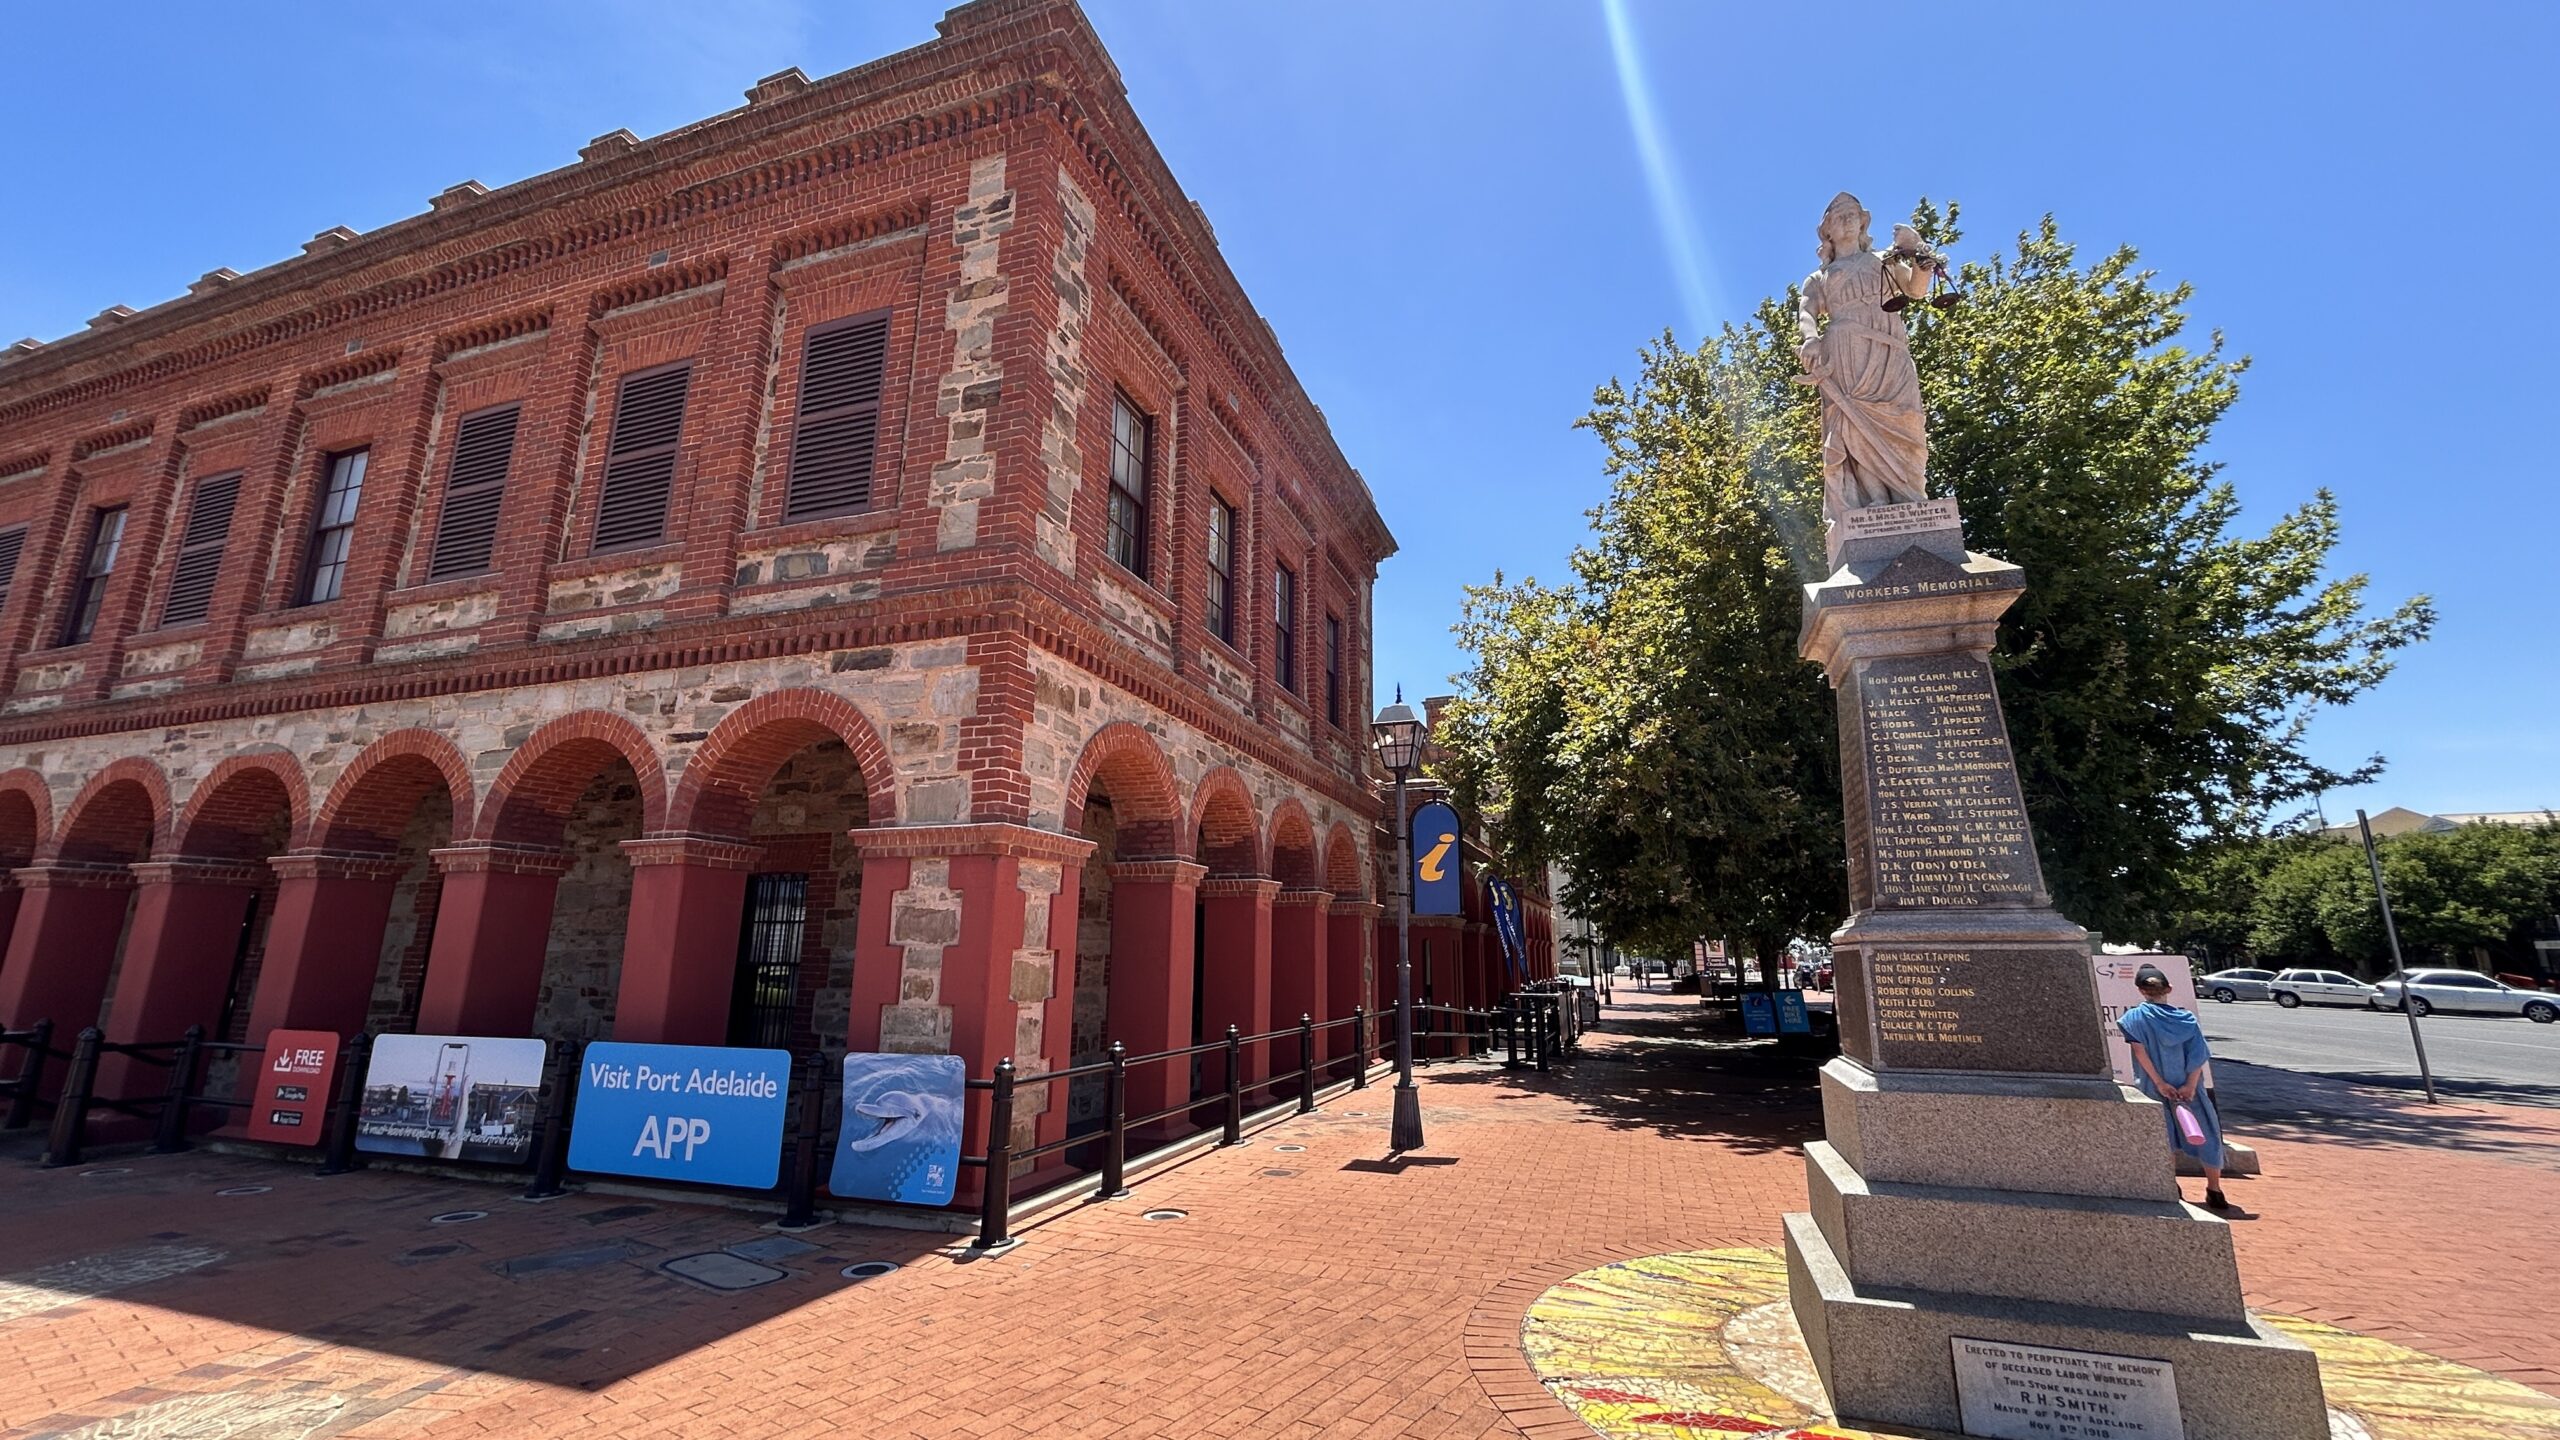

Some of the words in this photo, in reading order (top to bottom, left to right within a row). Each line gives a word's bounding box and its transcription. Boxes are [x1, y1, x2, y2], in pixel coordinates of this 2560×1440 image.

[1844, 585, 1910, 599] WORKERS
[1891, 675, 1917, 683] JOHN
[1916, 824, 1960, 833] CONDON
[1896, 849, 1921, 858] RUBY
[1925, 848, 1973, 858] HAMMOND
[1949, 860, 1986, 870] O'DEA
[1909, 873, 1954, 883] (JIMMY)
[1958, 872, 2003, 881] TUNCKS
[1911, 884, 1939, 893] JAMES
[1942, 883, 1966, 894] (JIM)
[1982, 882, 2032, 893] CAVANAGH
[1898, 896, 1915, 906] JIM
[1932, 895, 1978, 905] DOUGLAS
[1875, 952, 1898, 961] JOHN
[1899, 952, 1923, 962] (JACK)
[1932, 952, 1970, 962] TAPPING
[1874, 963, 1893, 973] RON
[1896, 963, 1941, 973] CONNOLLY
[1875, 975, 1893, 984] RON
[1898, 975, 1934, 985] GIFFARD
[1877, 986, 1909, 996] ROBERT
[1911, 987, 1935, 996] (BOB)
[1938, 987, 1975, 997] COLLINS
[1878, 998, 1904, 1007] KEITH
[1880, 1009, 1916, 1019] GEORGE
[1918, 1010, 1959, 1019] WHITTEN
[1880, 1020, 1913, 1030] EULALIE
[1937, 1021, 1958, 1031] TAPP
[1883, 1032, 1914, 1041] ARTHUR
[1939, 1033, 1983, 1043] MORTIMER
[294, 1048, 325, 1066] FREE
[590, 1062, 630, 1090] Visit
[636, 1065, 681, 1093] Port
[684, 1068, 777, 1099] Adelaide
[632, 1115, 711, 1162] APP
[1964, 1344, 2006, 1358] ERECTED
[2009, 1350, 2023, 1360] TO
[2027, 1353, 2089, 1368] PERPETUATE
[2092, 1360, 2114, 1371] THE
[2117, 1363, 2162, 1376] MEMORY
[1985, 1361, 1998, 1369] OF
[2001, 1362, 2052, 1376] DECEASED
[2055, 1368, 2090, 1382] LABOR
[2003, 1376, 2025, 1387] THIS
[2028, 1380, 2060, 1393] STONE
[2063, 1386, 2084, 1395] WAS
[2086, 1389, 2110, 1399] LAID
[2113, 1392, 2127, 1401] BY
[1994, 1402, 2028, 1415] MAYOR
[2035, 1410, 2048, 1418] OF
[2054, 1410, 2082, 1422] PORT
